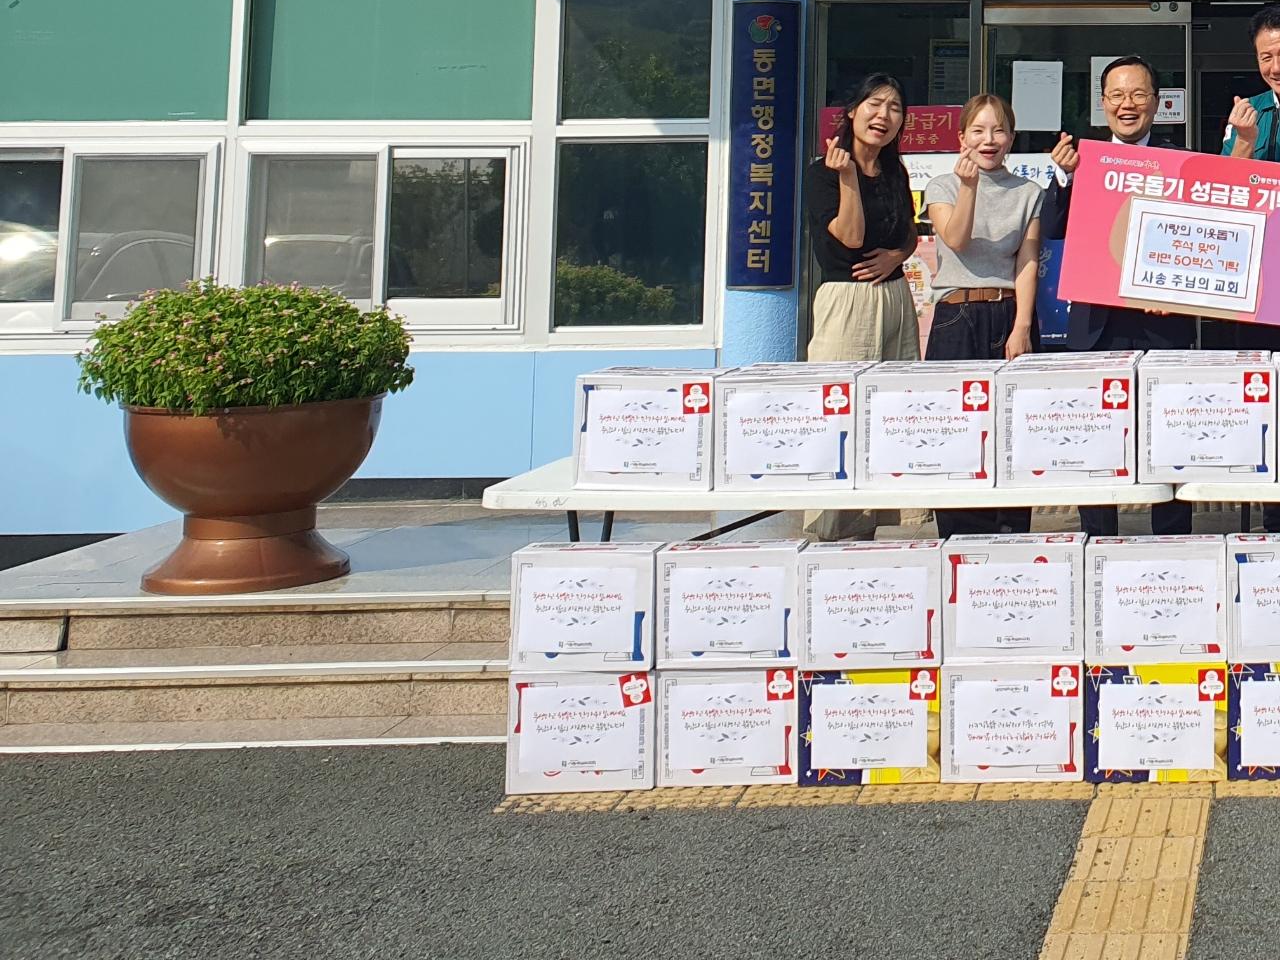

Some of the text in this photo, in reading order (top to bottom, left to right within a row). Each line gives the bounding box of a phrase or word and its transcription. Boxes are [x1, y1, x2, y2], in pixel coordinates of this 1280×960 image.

[746, 48, 777, 273] 동면행정복지센터
[1104, 170, 1184, 199] 이웃돕기
[1190, 181, 1250, 207] 성금품
[1157, 223, 1239, 242] 사랑의 이웃돕기
[1171, 239, 1220, 255] 추석 맞이
[1148, 251, 1239, 272] 라면 50박스 기탁
[1141, 270, 1239, 294] 사송 주님의 교회
